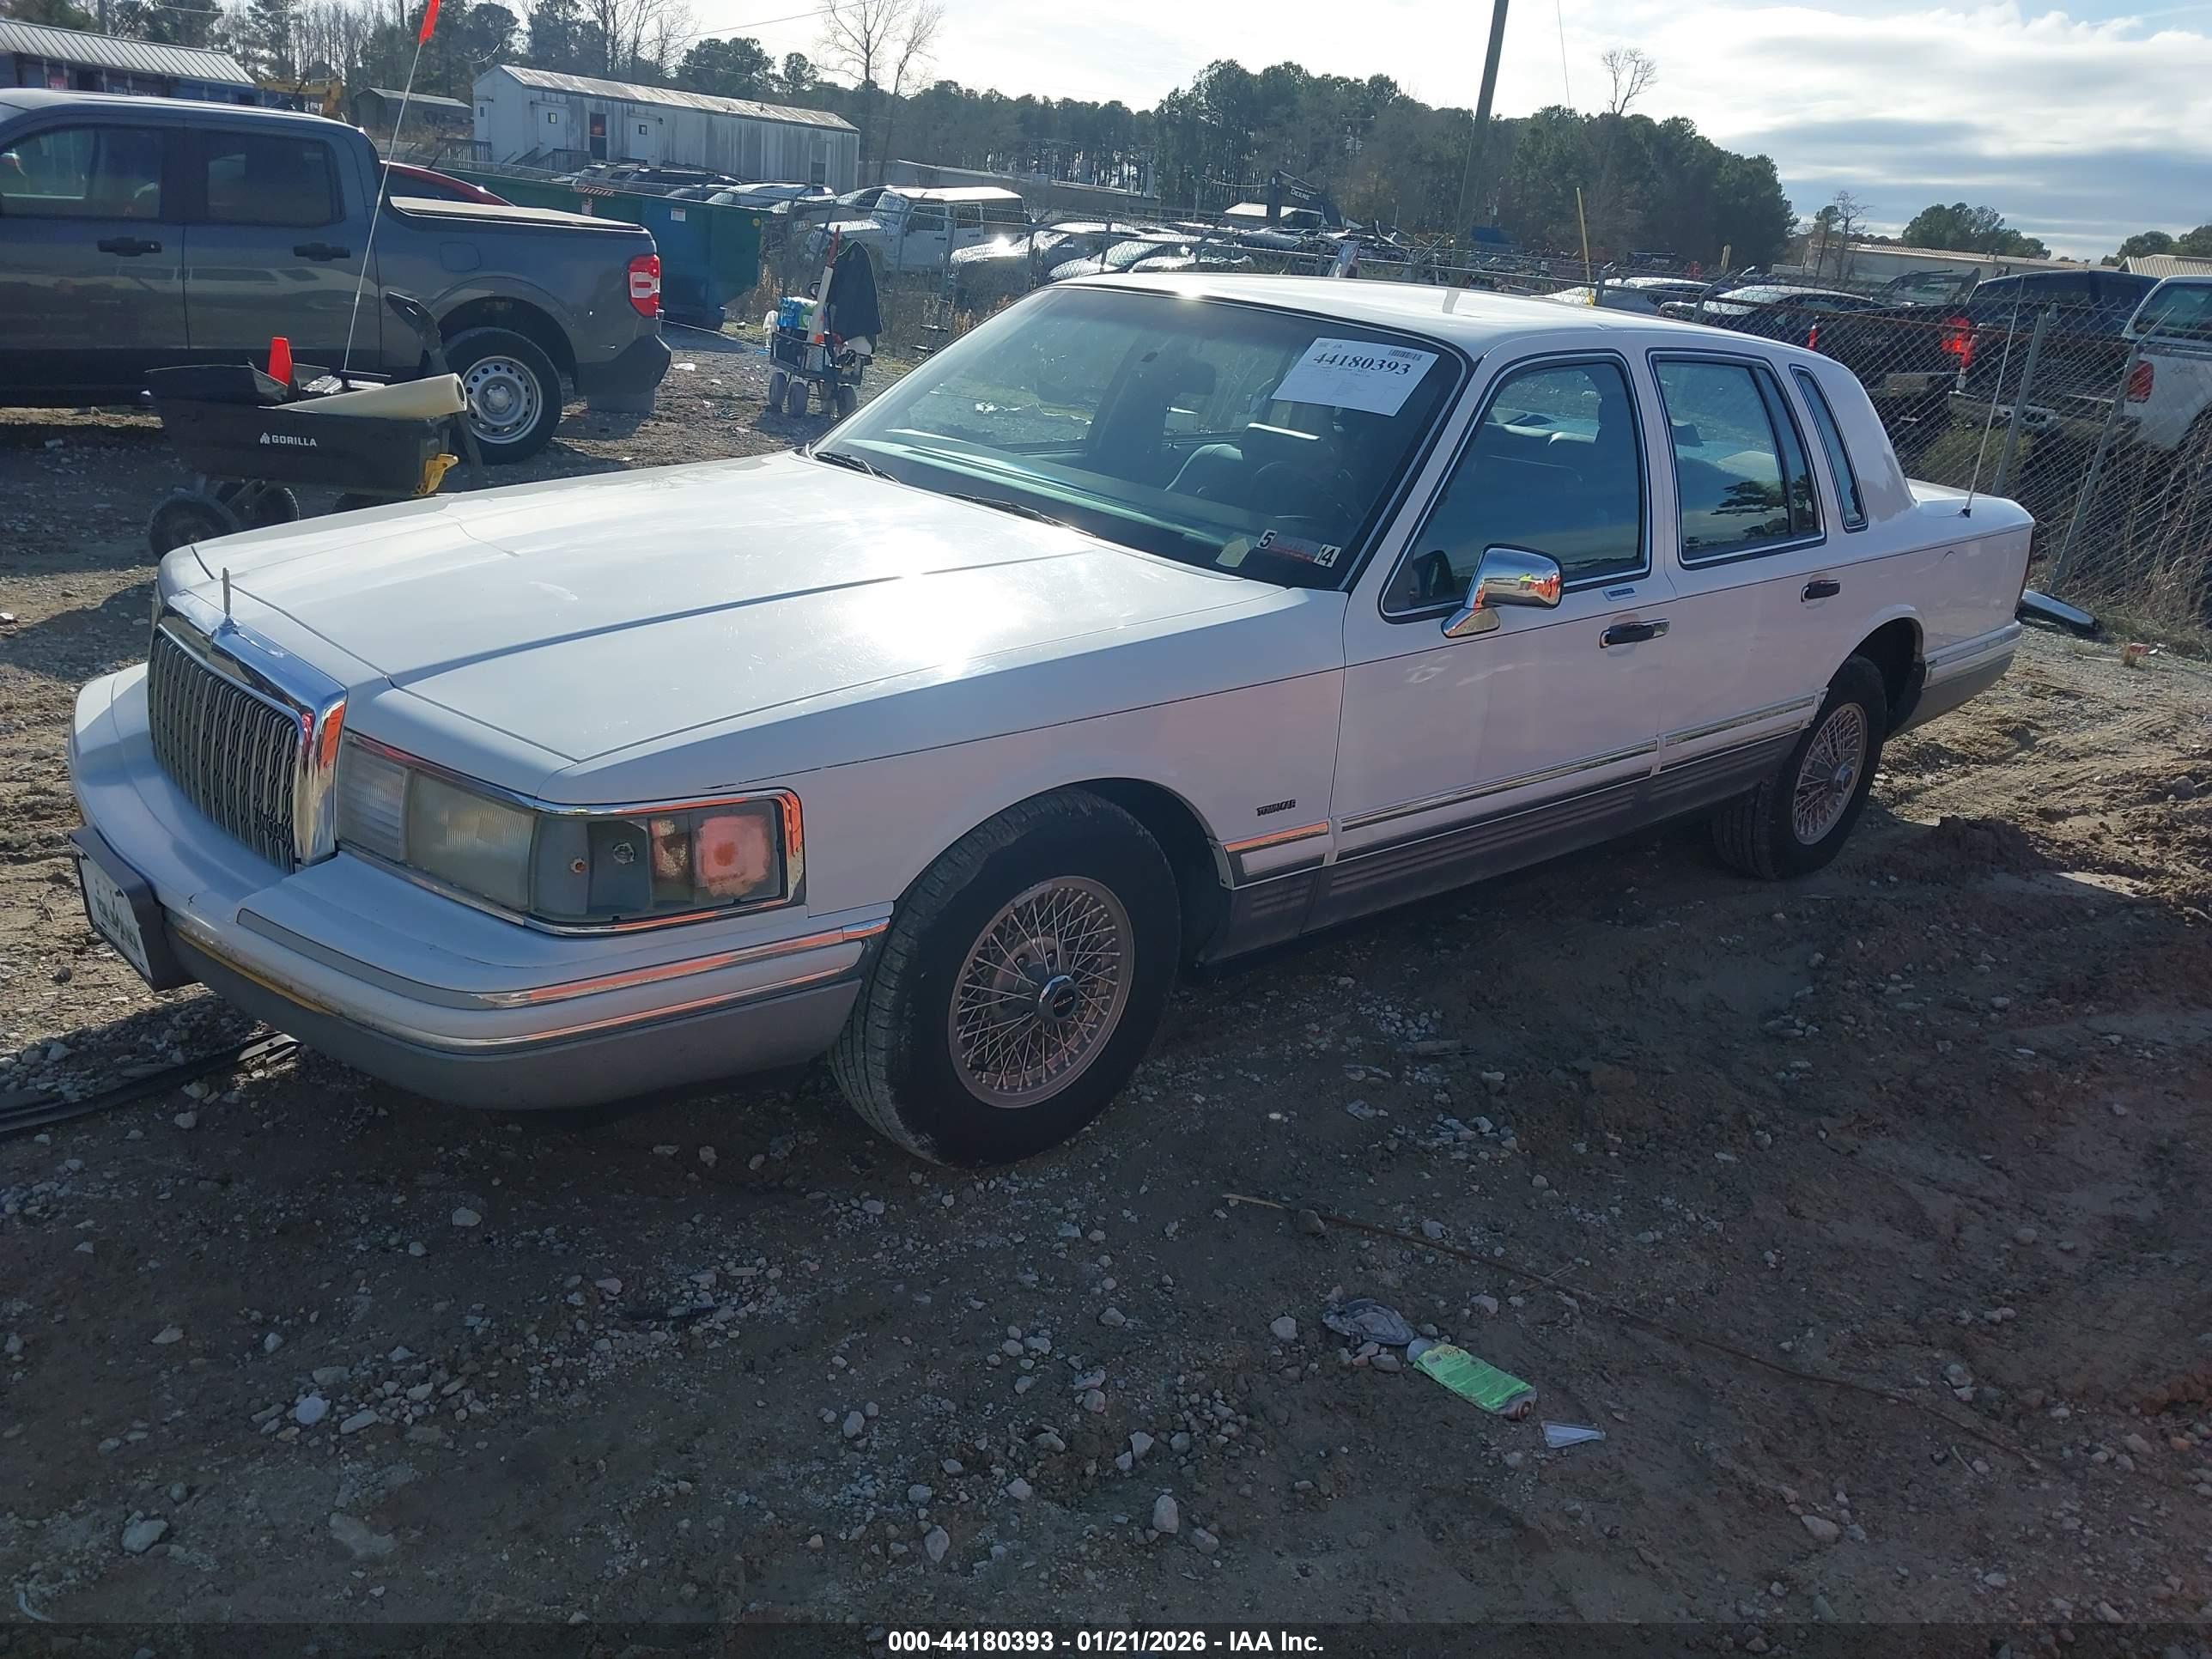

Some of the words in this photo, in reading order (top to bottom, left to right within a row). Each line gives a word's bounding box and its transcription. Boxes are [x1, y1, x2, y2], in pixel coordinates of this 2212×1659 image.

[1290, 188, 1311, 201] DEERE
[1312, 352, 1412, 376] 44180393
[271, 434, 318, 447] GORILLA
[1259, 532, 1276, 548] 5
[1316, 545, 1338, 566] 14
